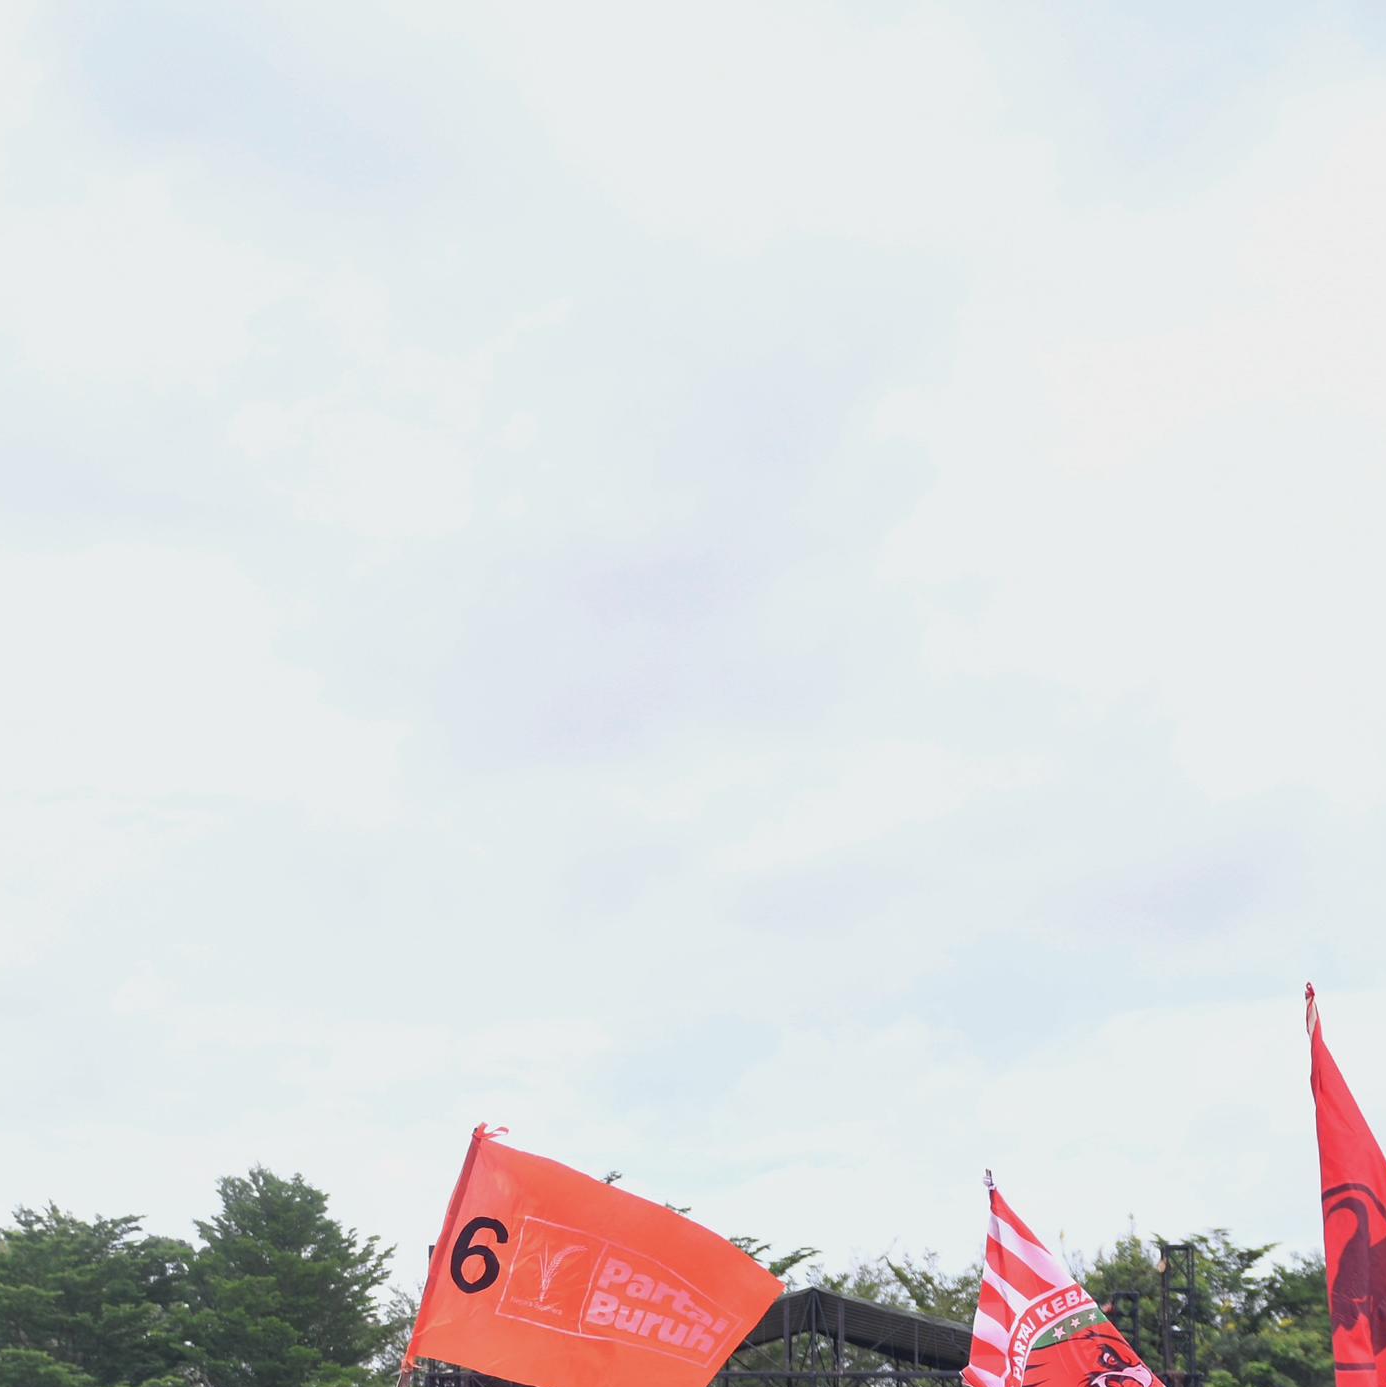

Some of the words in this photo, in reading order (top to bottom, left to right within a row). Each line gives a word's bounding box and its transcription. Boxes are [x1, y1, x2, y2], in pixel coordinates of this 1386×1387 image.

[450, 1216, 509, 1294] 6
[585, 1290, 715, 1353] Buruh
[597, 1256, 729, 1335] Partai
[1012, 1319, 1037, 1382] PARTAI
